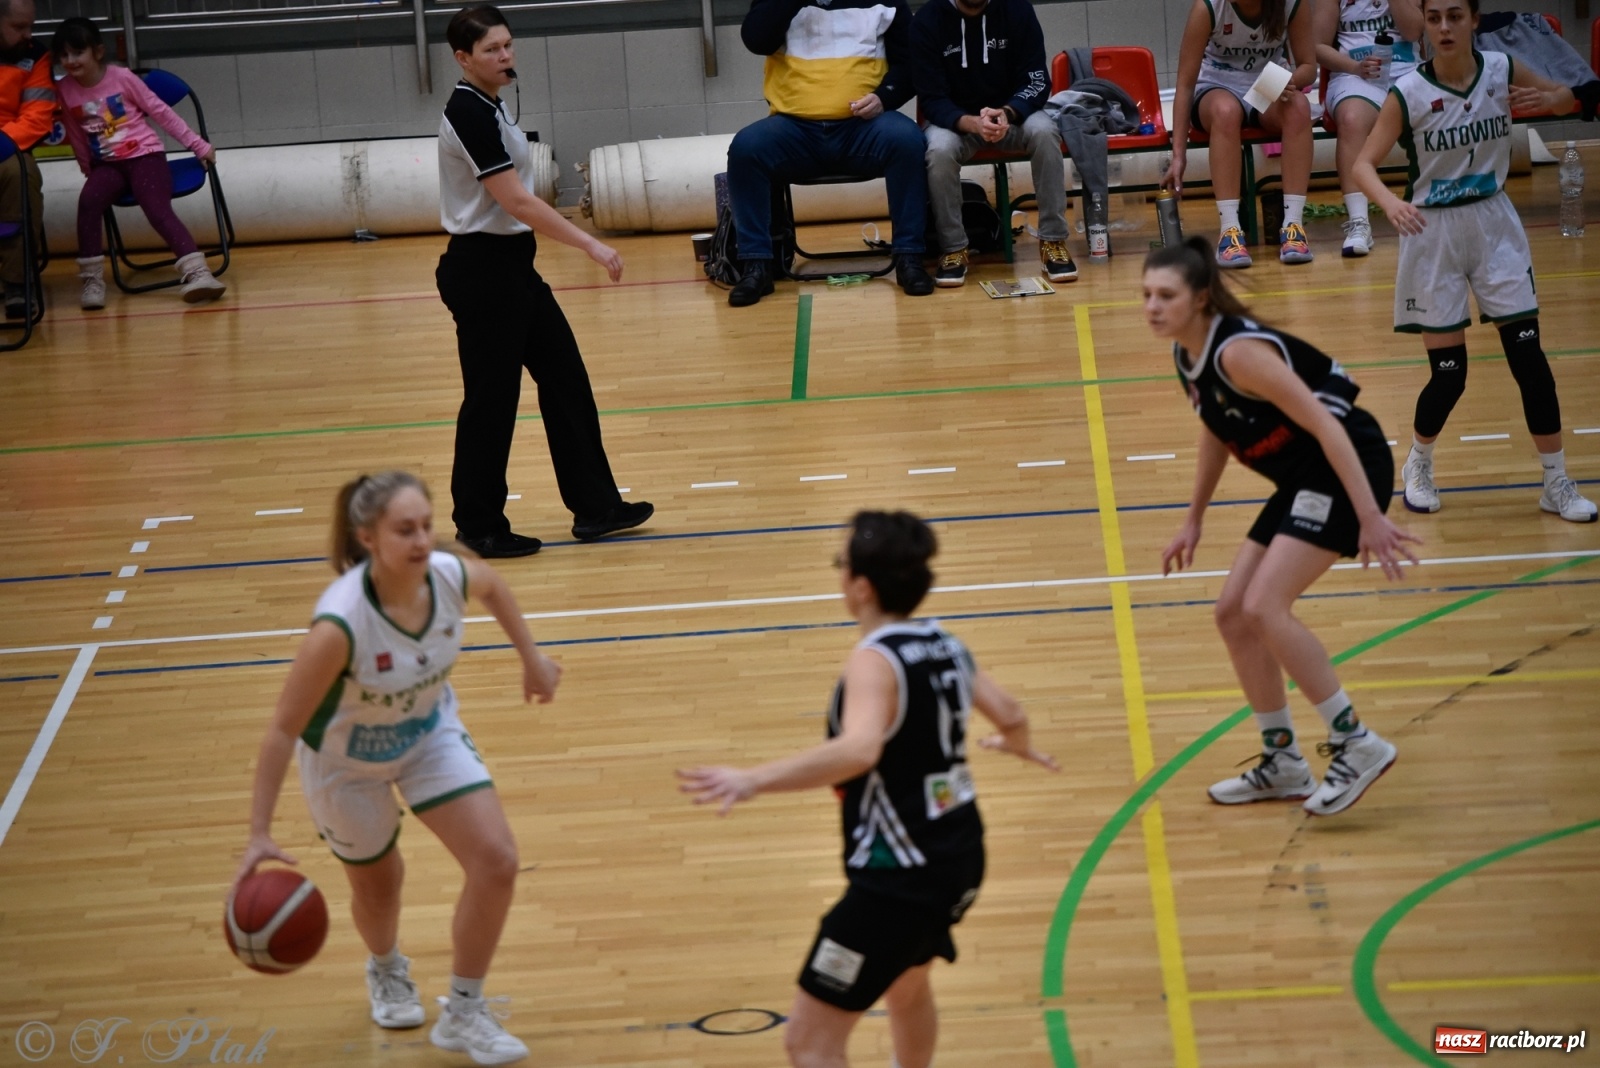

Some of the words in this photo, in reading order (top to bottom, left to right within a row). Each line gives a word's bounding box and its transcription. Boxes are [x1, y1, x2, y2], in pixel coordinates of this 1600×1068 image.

[1243, 56, 1256, 72] 6
[1423, 114, 1510, 153] KATOWICE
[1467, 147, 1475, 169] 1
[1526, 265, 1536, 295] 1
